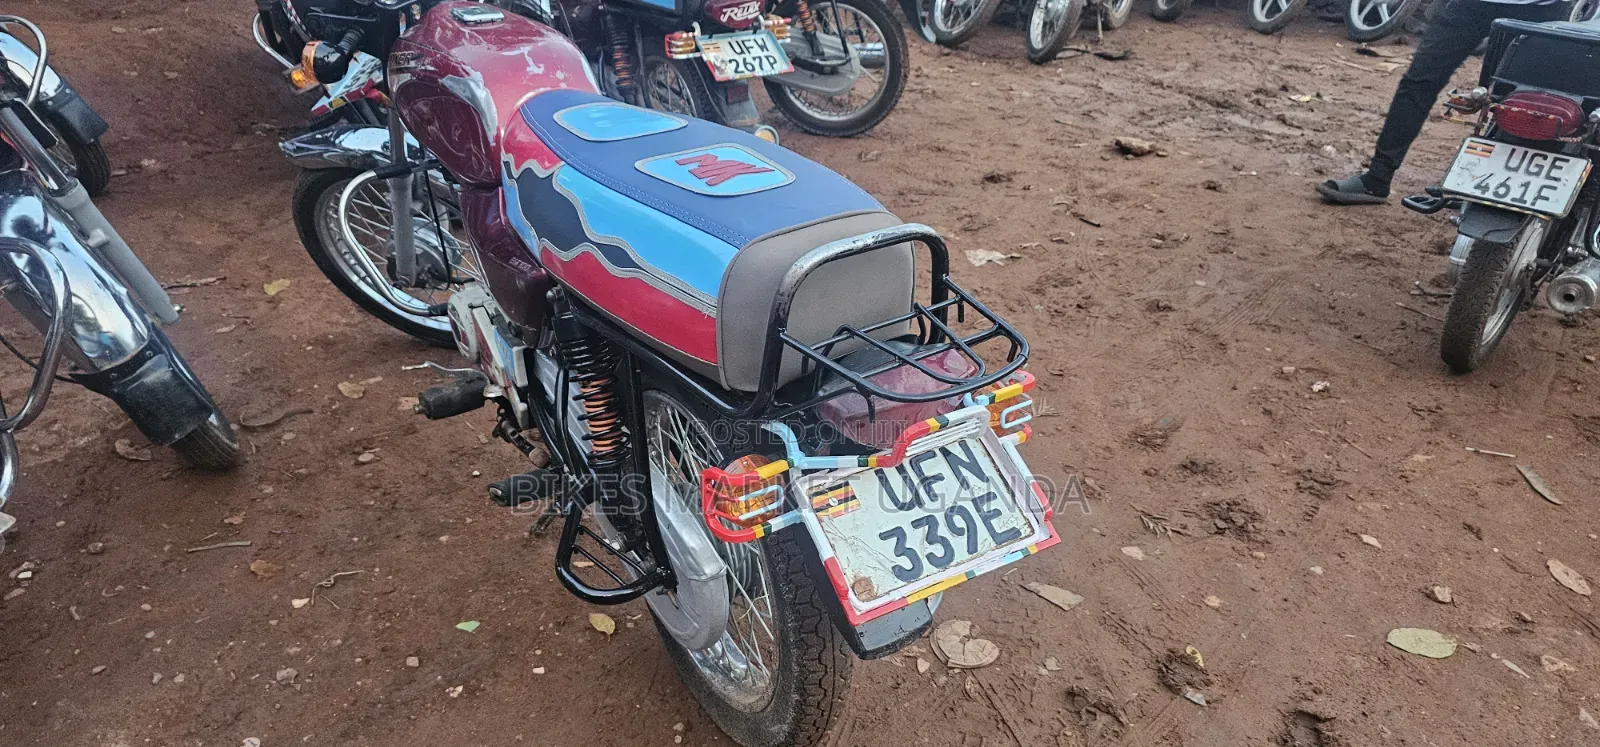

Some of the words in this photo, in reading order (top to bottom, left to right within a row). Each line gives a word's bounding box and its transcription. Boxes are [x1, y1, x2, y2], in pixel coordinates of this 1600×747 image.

[728, 38, 769, 55] UFW
[728, 55, 777, 74] 267P
[1504, 148, 1570, 182] UGE
[1473, 173, 1558, 206] 461F
[875, 440, 990, 512] UFN
[879, 491, 1022, 583] 339E
